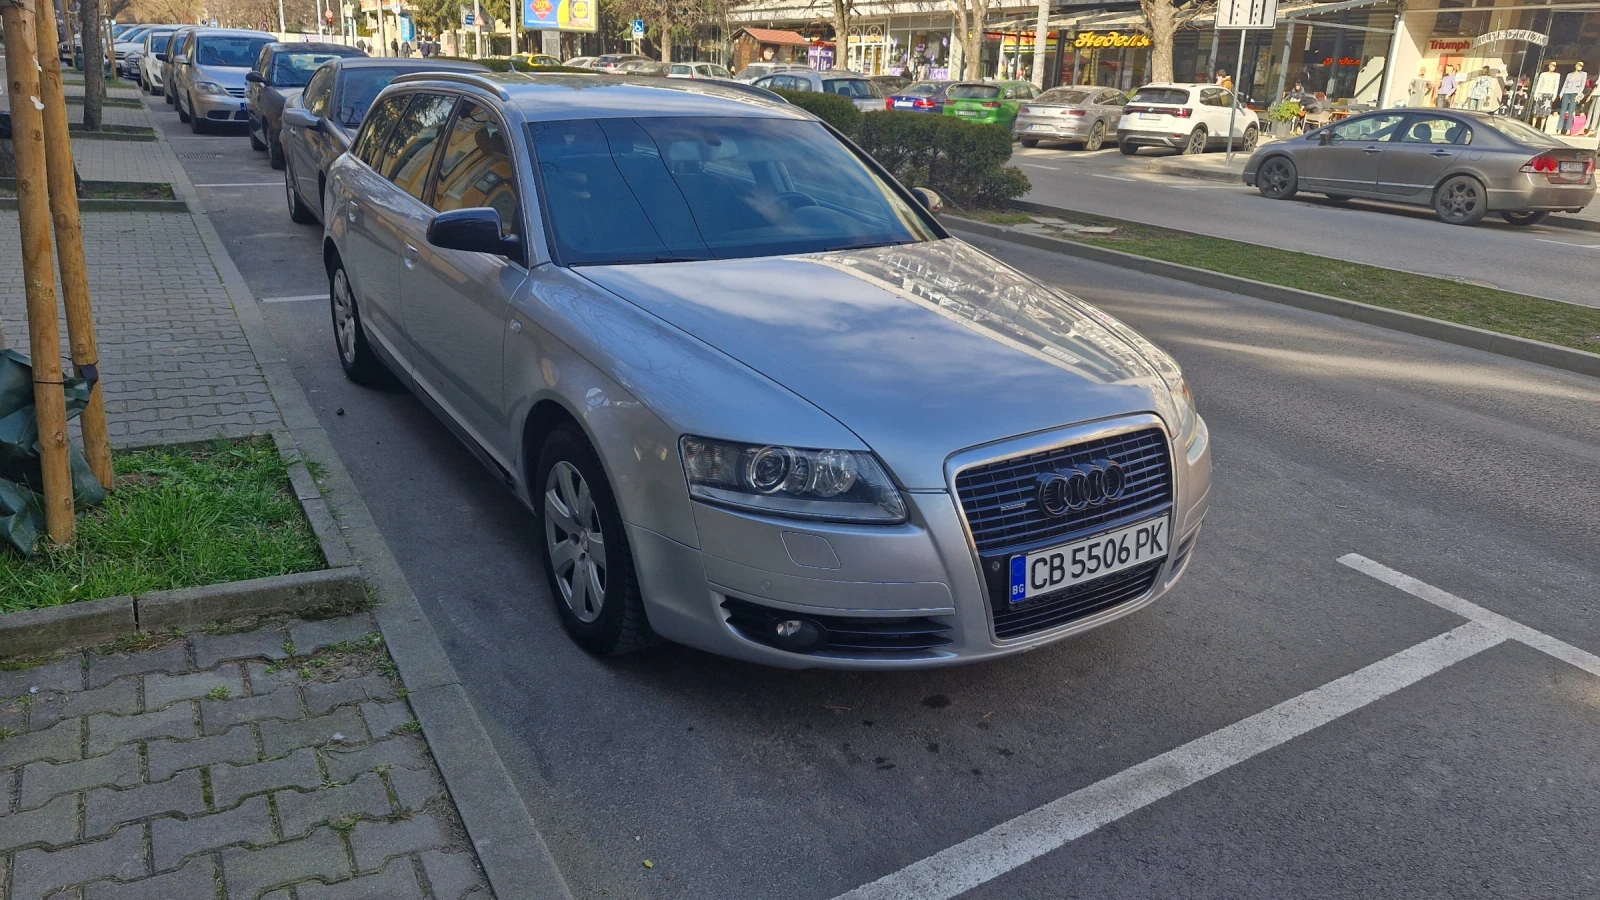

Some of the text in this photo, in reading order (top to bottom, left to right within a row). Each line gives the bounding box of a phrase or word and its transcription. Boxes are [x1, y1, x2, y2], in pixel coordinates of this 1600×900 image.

[1075, 31, 1151, 48] Неделя
[1430, 39, 1470, 52] Triumph
[1031, 521, 1164, 590] CB 5506 PK
[1012, 584, 1025, 595] BG
